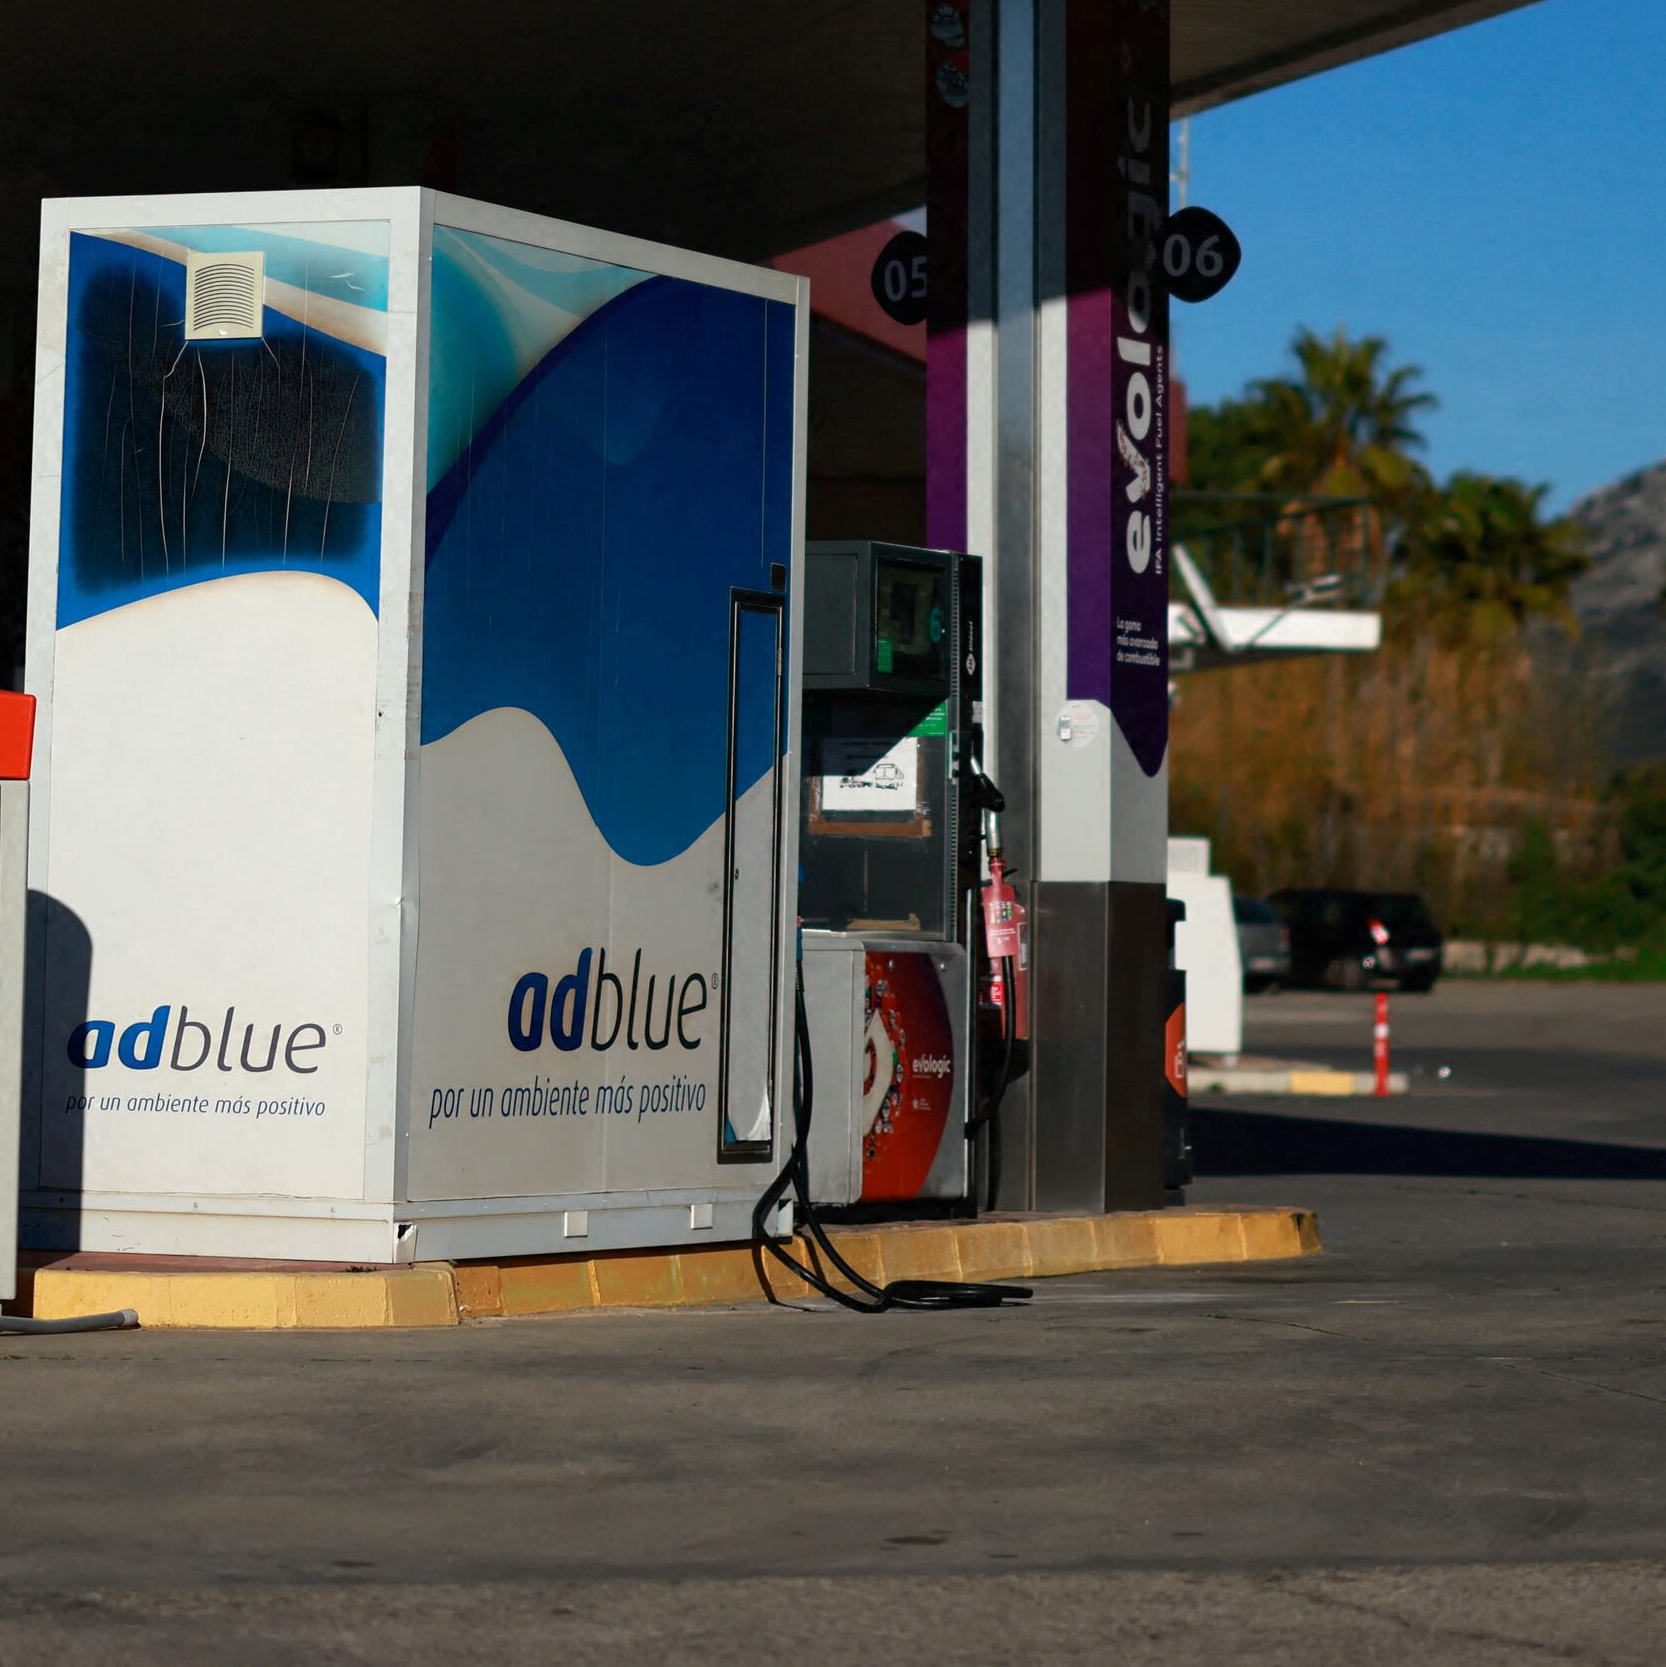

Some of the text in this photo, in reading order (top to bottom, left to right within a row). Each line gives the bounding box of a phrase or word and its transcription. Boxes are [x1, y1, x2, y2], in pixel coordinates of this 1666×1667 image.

[883, 254, 929, 303] 05
[1161, 232, 1224, 278] 06
[1115, 95, 1160, 575] evologic
[1155, 344, 1164, 408] Agents
[1155, 412, 1164, 449] Fuel
[1155, 452, 1164, 542] Intelligent
[912, 1053, 951, 1079] evologic
[65, 1093, 326, 1119] por un ambiente más positivo
[428, 1075, 707, 1130] por un ambiente más positivo
